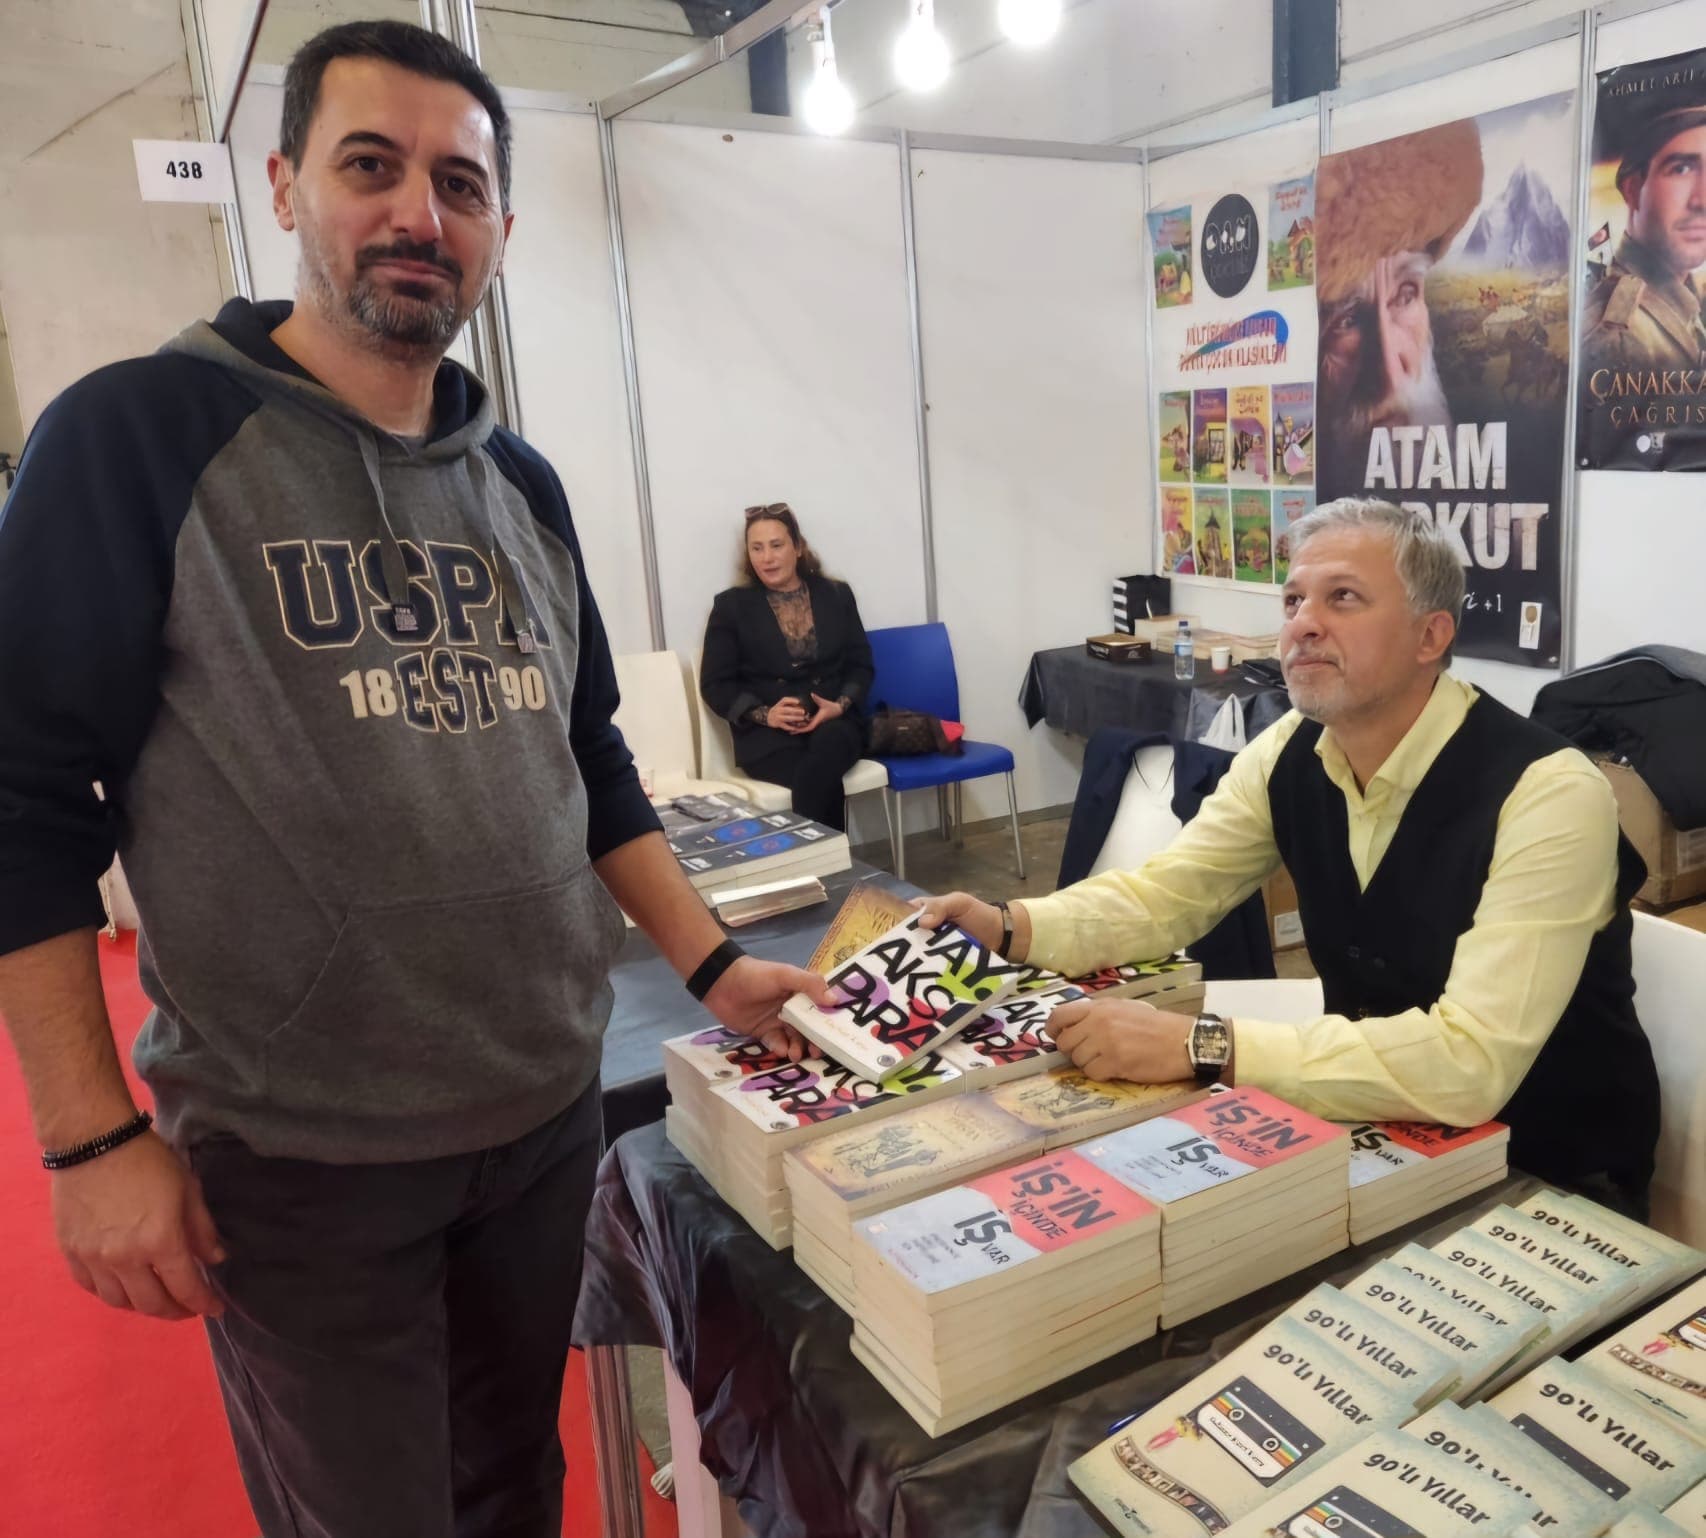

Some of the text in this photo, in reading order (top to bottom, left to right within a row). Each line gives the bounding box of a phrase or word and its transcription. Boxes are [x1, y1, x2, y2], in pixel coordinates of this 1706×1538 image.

[166, 161, 203, 178] 438
[1364, 421, 1507, 490] ATAM
[339, 647, 546, 733] 18 EST 90
[1010, 1160, 1116, 1230] İŞ'İN
[953, 1208, 1013, 1246] İŞ
[980, 1242, 1010, 1266] VAR
